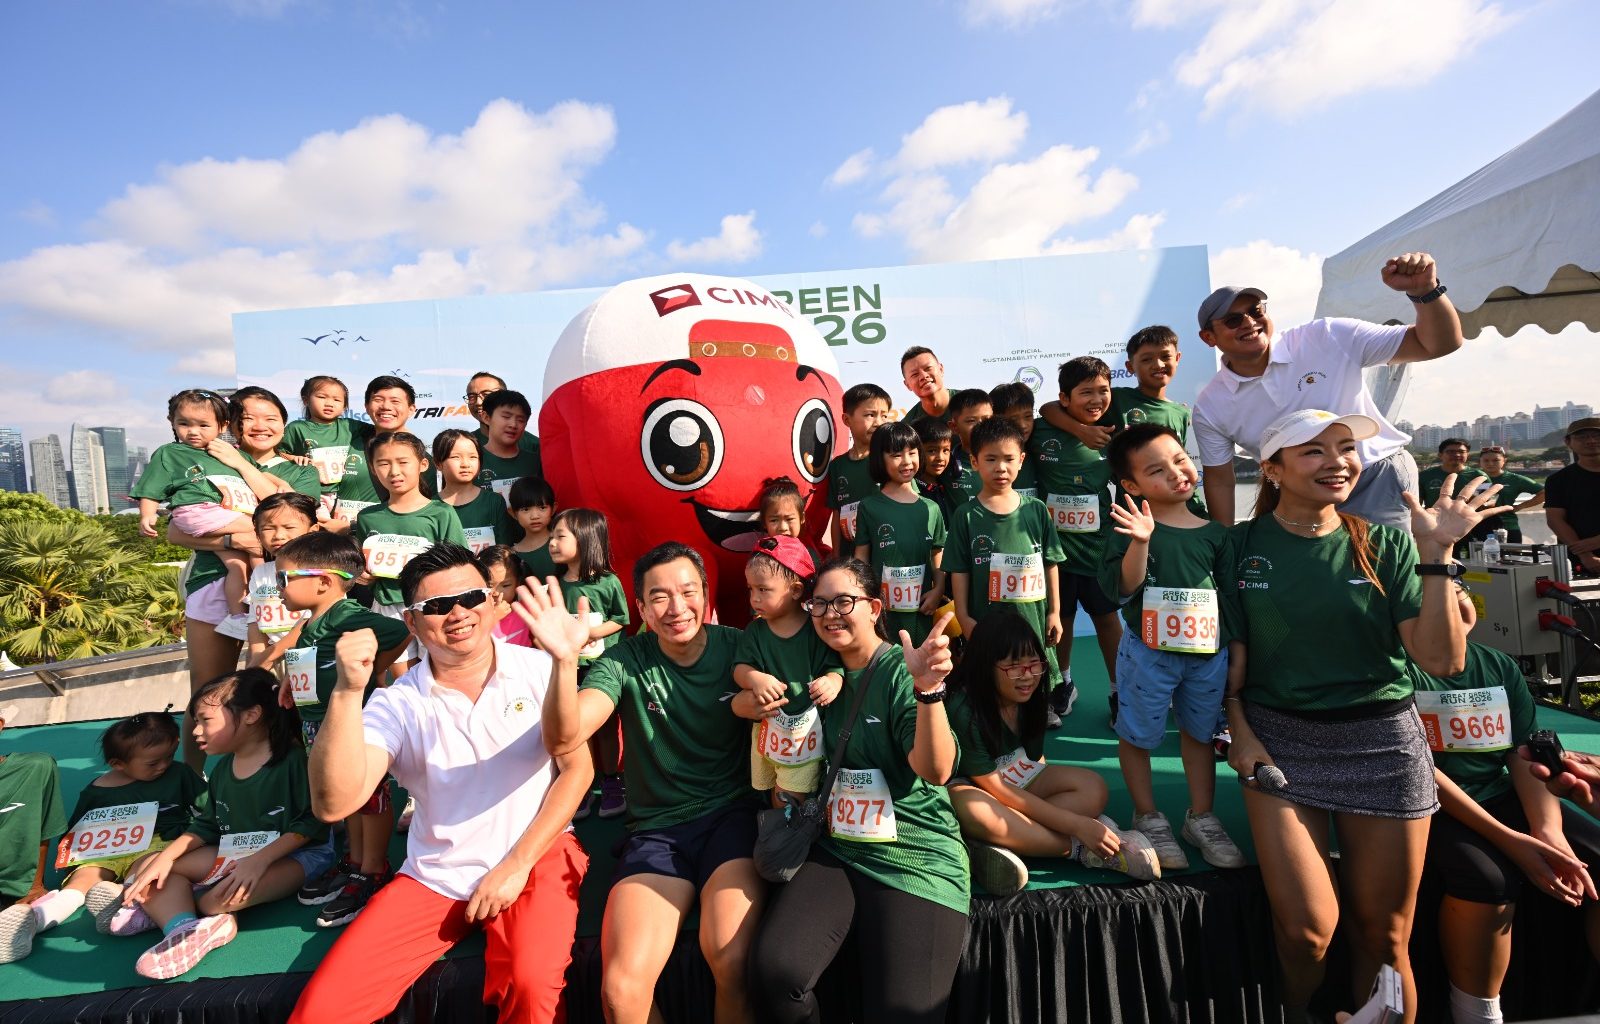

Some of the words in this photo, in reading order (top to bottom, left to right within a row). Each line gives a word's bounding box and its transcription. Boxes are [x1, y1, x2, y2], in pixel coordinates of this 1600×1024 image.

[706, 286, 794, 319] CIMB
[770, 283, 882, 314] REEN
[813, 311, 887, 347] 26
[982, 355, 1038, 363] SUSTAINABILITY
[413, 405, 470, 419] TRIFA
[1057, 511, 1095, 525] 9679
[893, 584, 922, 603] 917
[1007, 572, 1043, 593] 9176
[1166, 614, 1217, 639] 9336
[1449, 713, 1505, 740] 9664
[770, 731, 817, 757] 9276
[1002, 759, 1035, 785] 174
[836, 797, 885, 826] 9277
[77, 825, 145, 852] 9259
